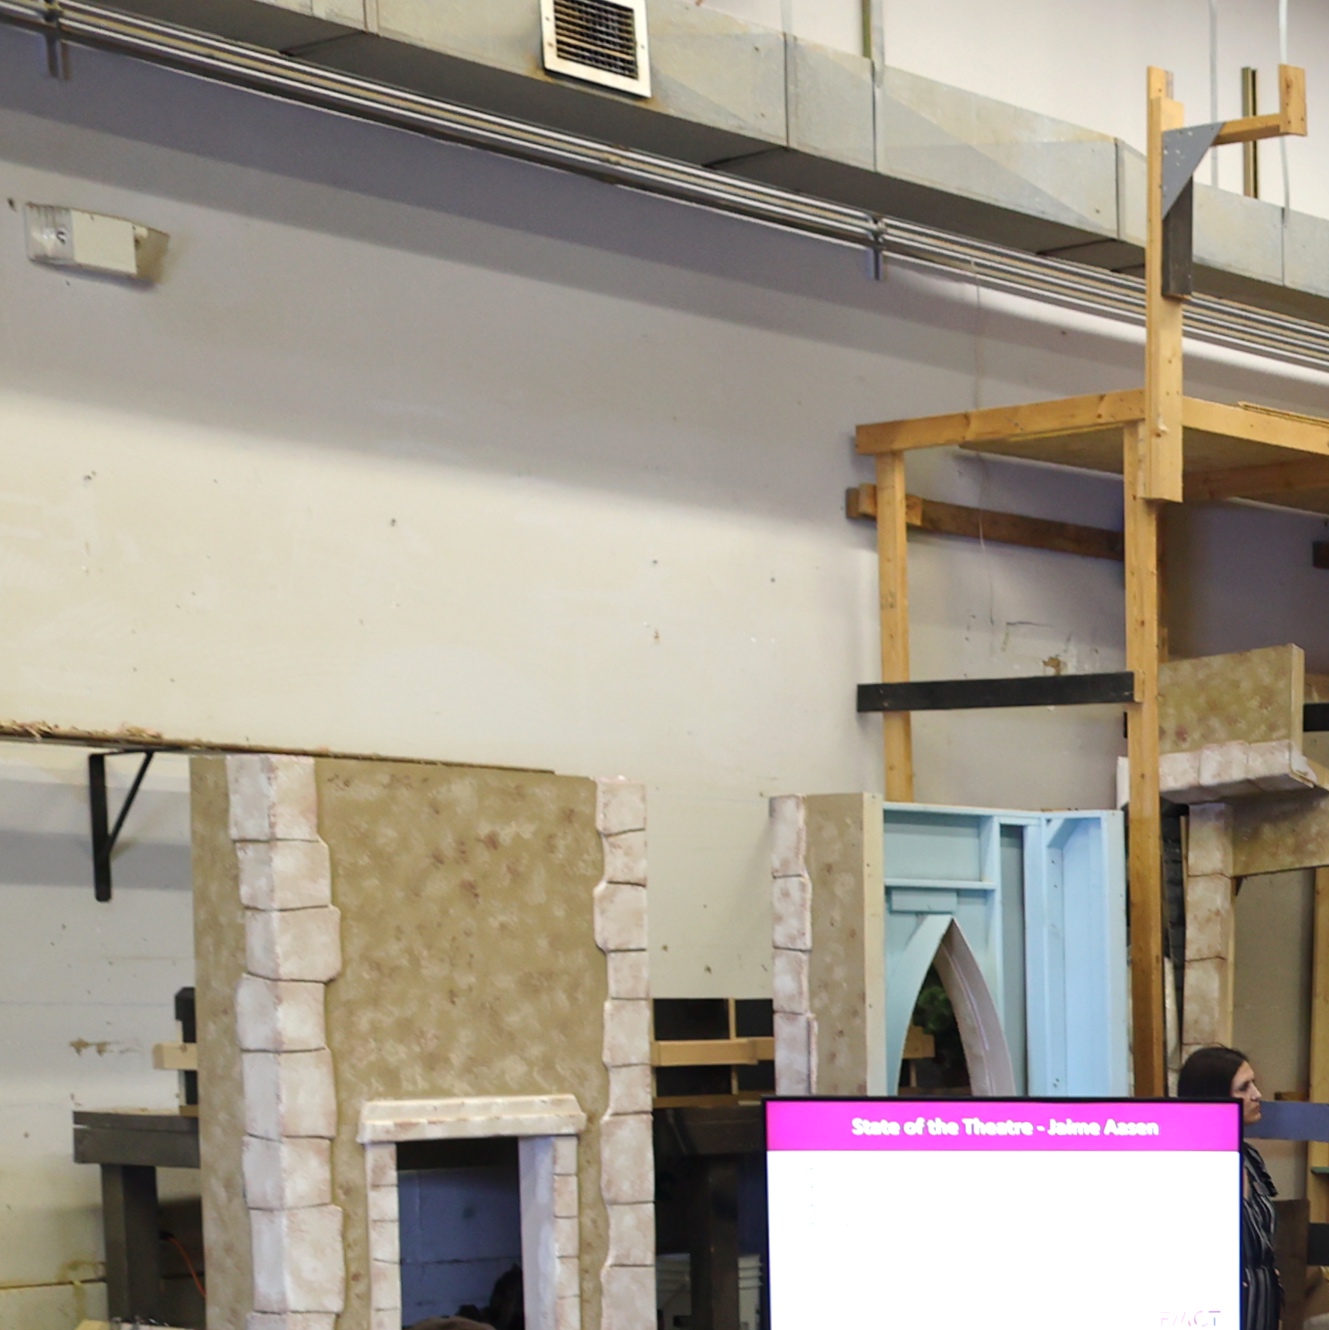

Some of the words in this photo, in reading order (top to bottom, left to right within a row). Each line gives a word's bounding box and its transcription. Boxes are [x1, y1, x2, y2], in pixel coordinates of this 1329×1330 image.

[851, 1117, 900, 1136] State
[903, 1117, 926, 1135] of
[927, 1117, 960, 1136] the
[962, 1117, 1033, 1136] Theatre
[1047, 1118, 1100, 1136] Jaime
[1103, 1119, 1159, 1136] Aasen
